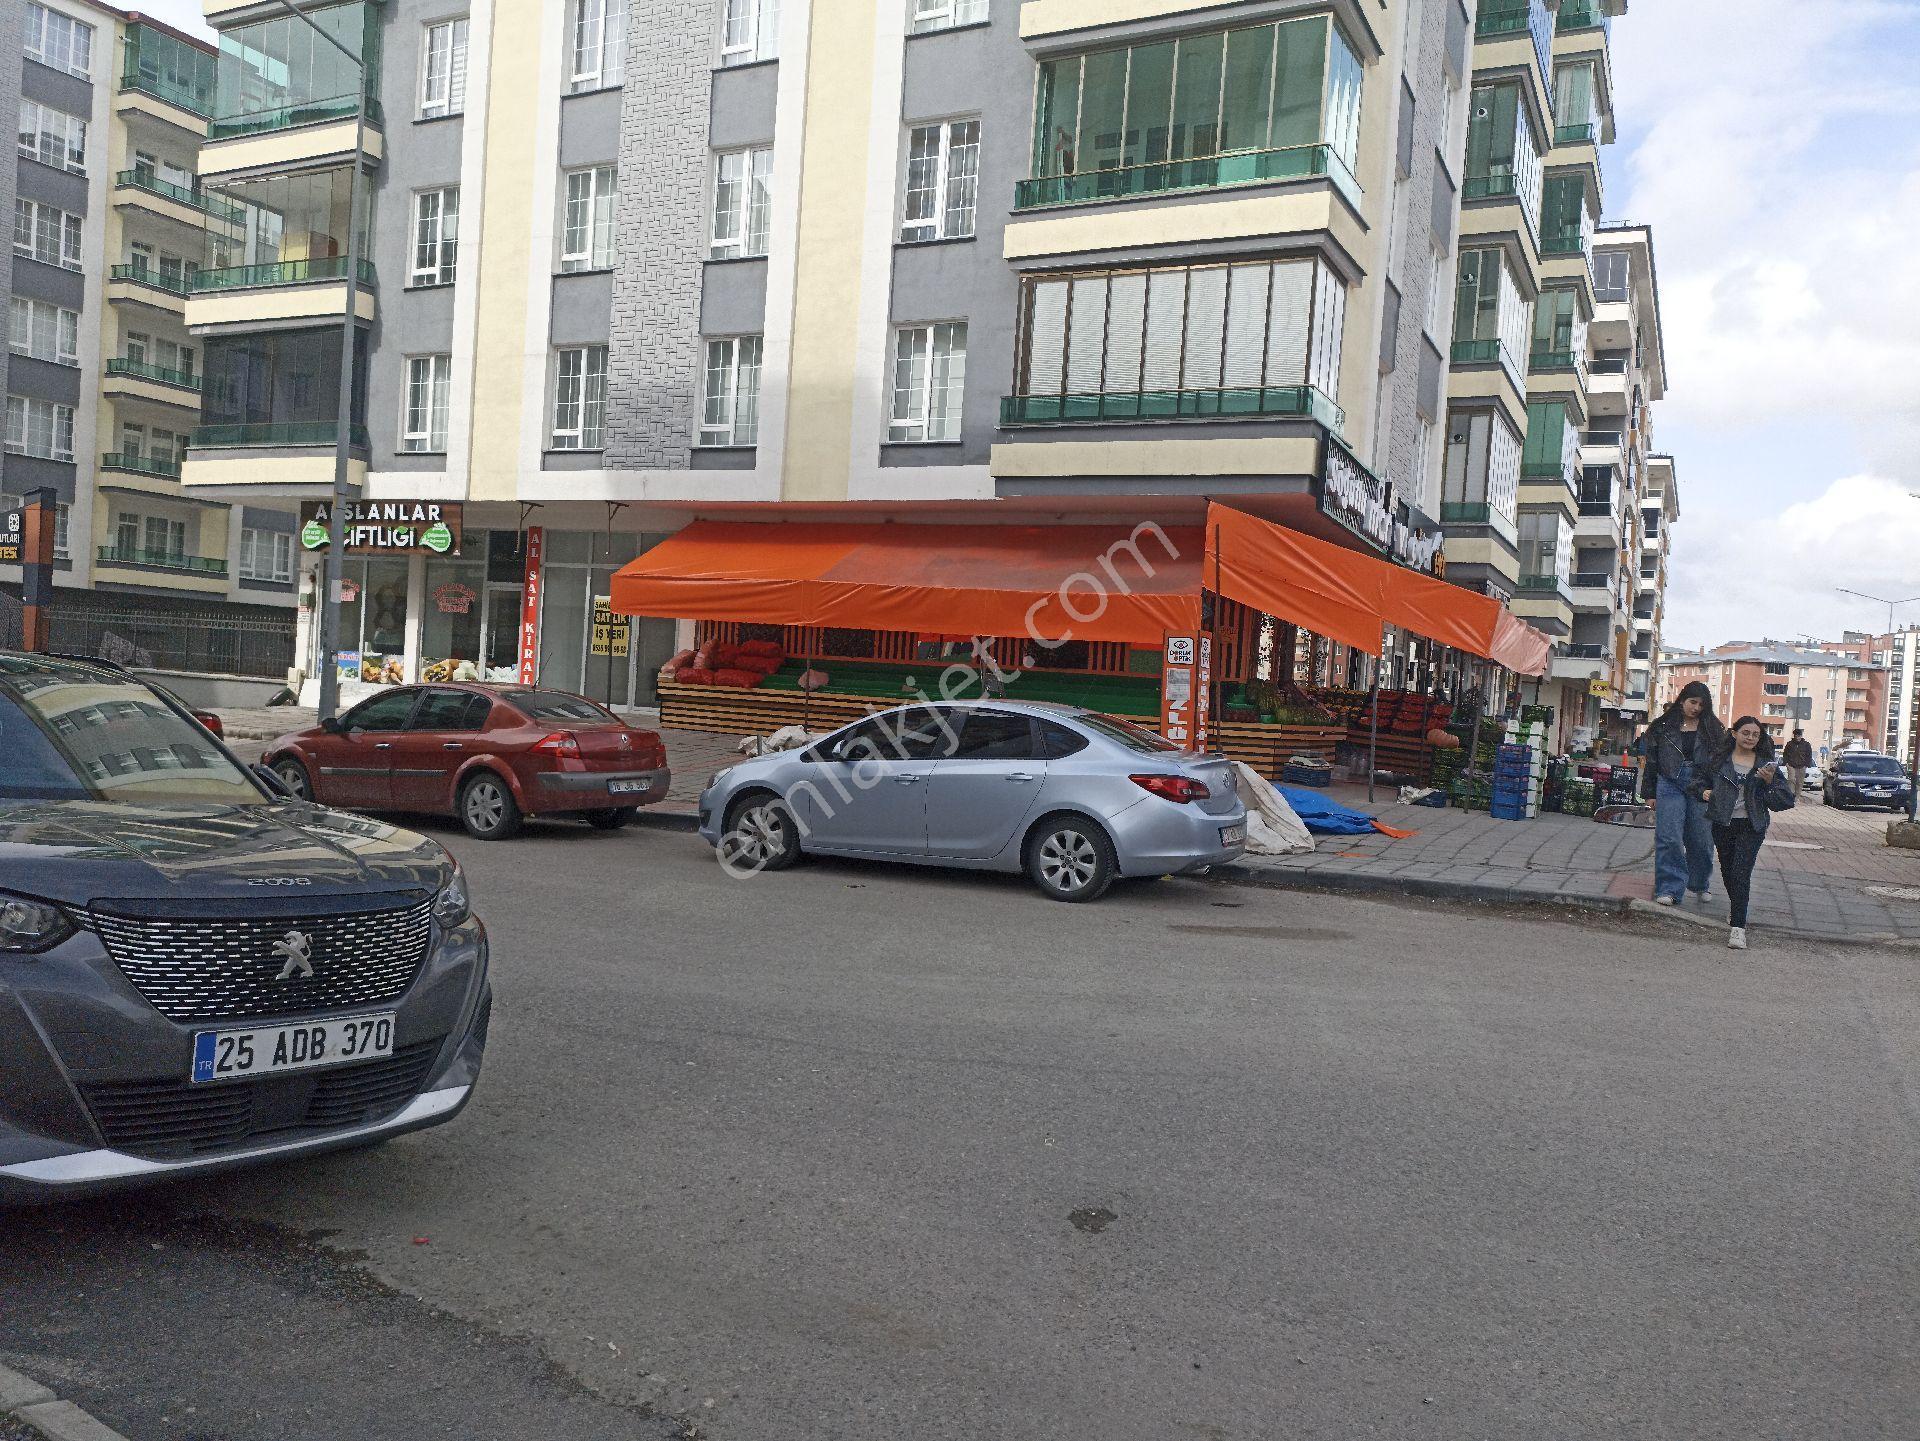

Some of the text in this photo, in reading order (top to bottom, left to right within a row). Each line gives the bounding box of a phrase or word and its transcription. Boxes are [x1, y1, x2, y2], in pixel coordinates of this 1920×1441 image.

[315, 503, 440, 520] ASLANLAR
[530, 533, 540, 558] AL
[527, 570, 537, 607] SAT
[595, 611, 629, 624] SATLIK
[247, 877, 312, 886] 2008
[216, 1018, 391, 1073] 25 ADB 370
[199, 1059, 213, 1071] TR
